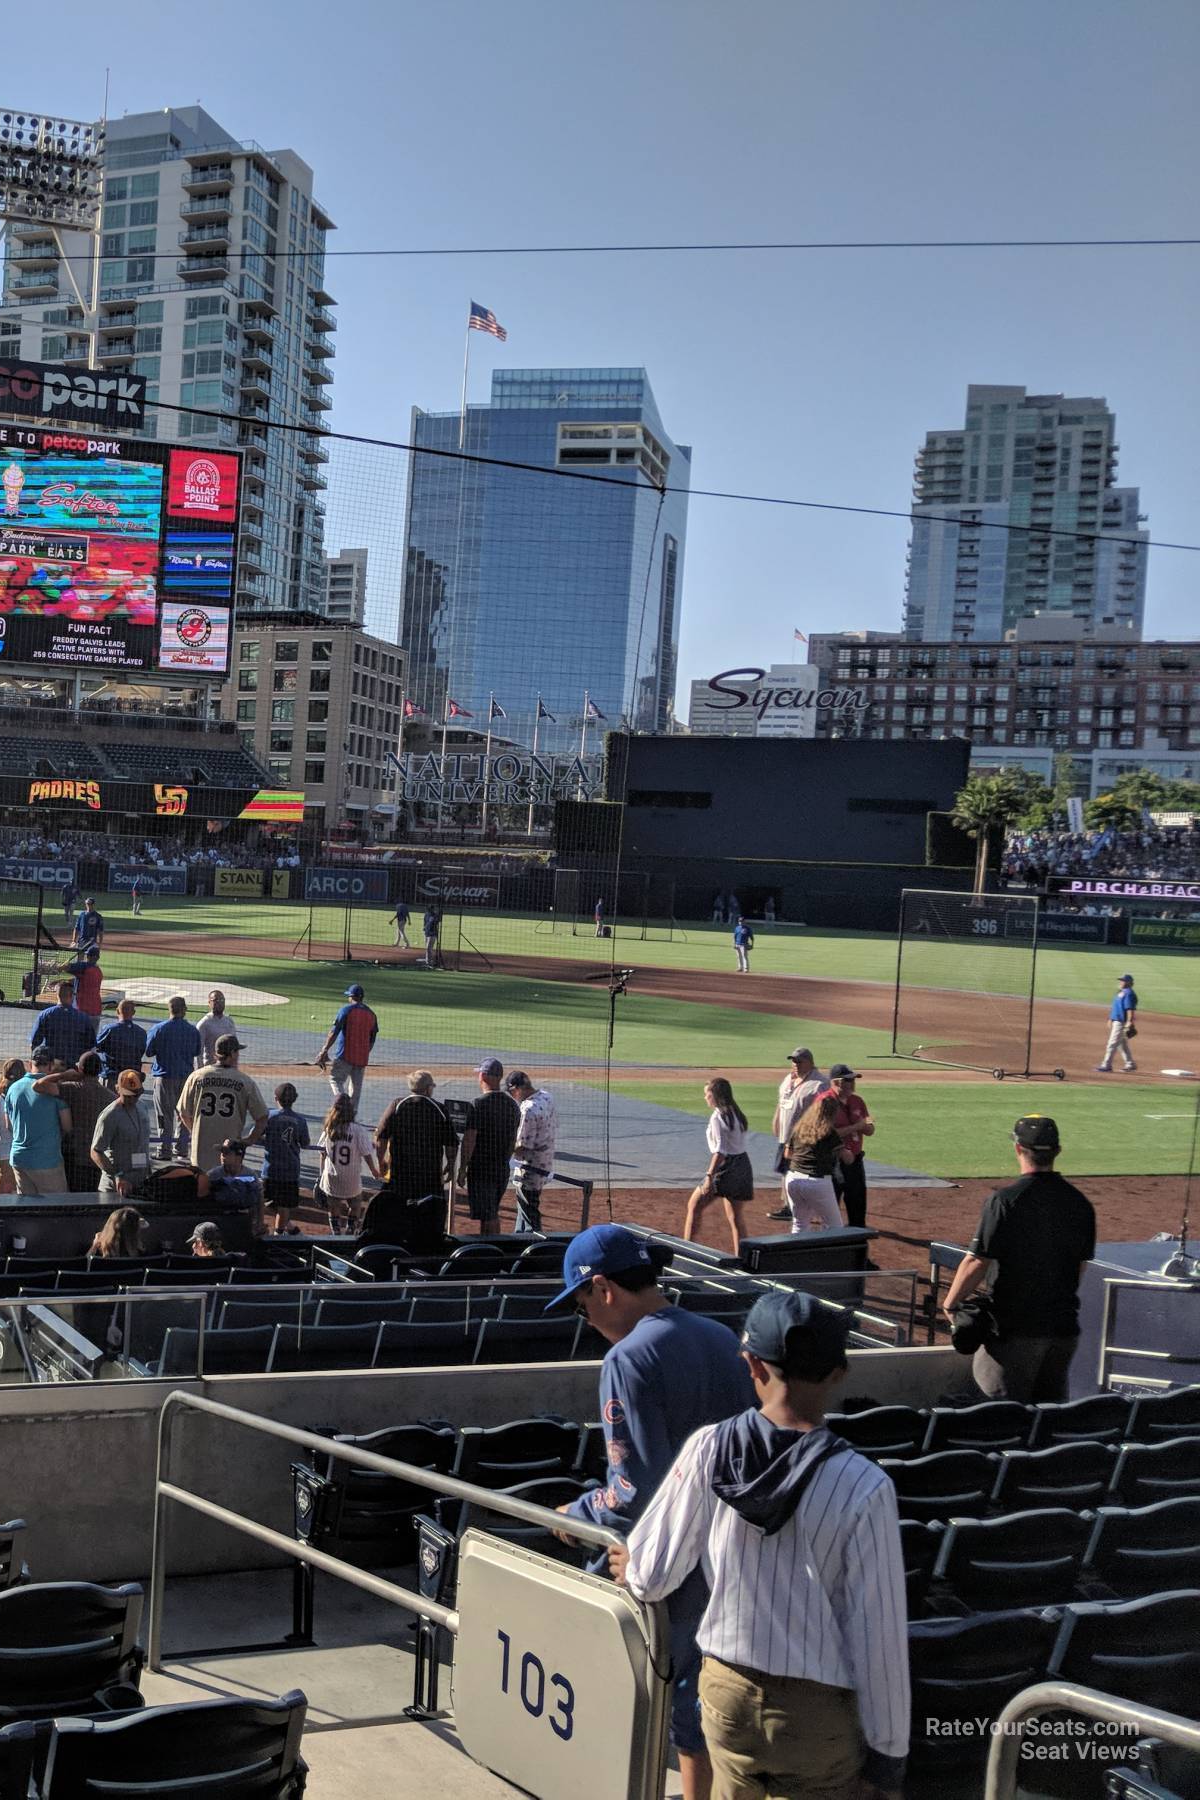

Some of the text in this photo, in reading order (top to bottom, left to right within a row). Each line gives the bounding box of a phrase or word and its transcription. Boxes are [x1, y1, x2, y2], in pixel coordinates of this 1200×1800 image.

[17, 432, 36, 444] TO
[185, 485, 220, 496] BALLAST
[38, 483, 120, 515] Softee
[189, 494, 215, 504] POINT
[48, 547, 84, 560] EATS
[68, 624, 112, 635] FUN FACT
[52, 636, 126, 648] FREDDY GALVIS LEADS
[52, 644, 76, 653] ACTIVE
[78, 646, 107, 655] PLAYERS
[47, 652, 93, 661] CONSECUTIVE
[119, 658, 144, 666] PLAYED
[704, 667, 873, 720] Sycuan
[29, 780, 100, 809] PADRES
[400, 781, 600, 804] UNIVERSITY
[308, 877, 364, 894] ARCO
[425, 877, 490, 897] Sycuan
[1071, 881, 1136, 894] PIRCH
[972, 919, 997, 935] 396
[200, 1092, 235, 1117] 33
[281, 1126, 294, 1143] 4
[331, 1146, 350, 1166] 19
[498, 1628, 575, 1741] 103
